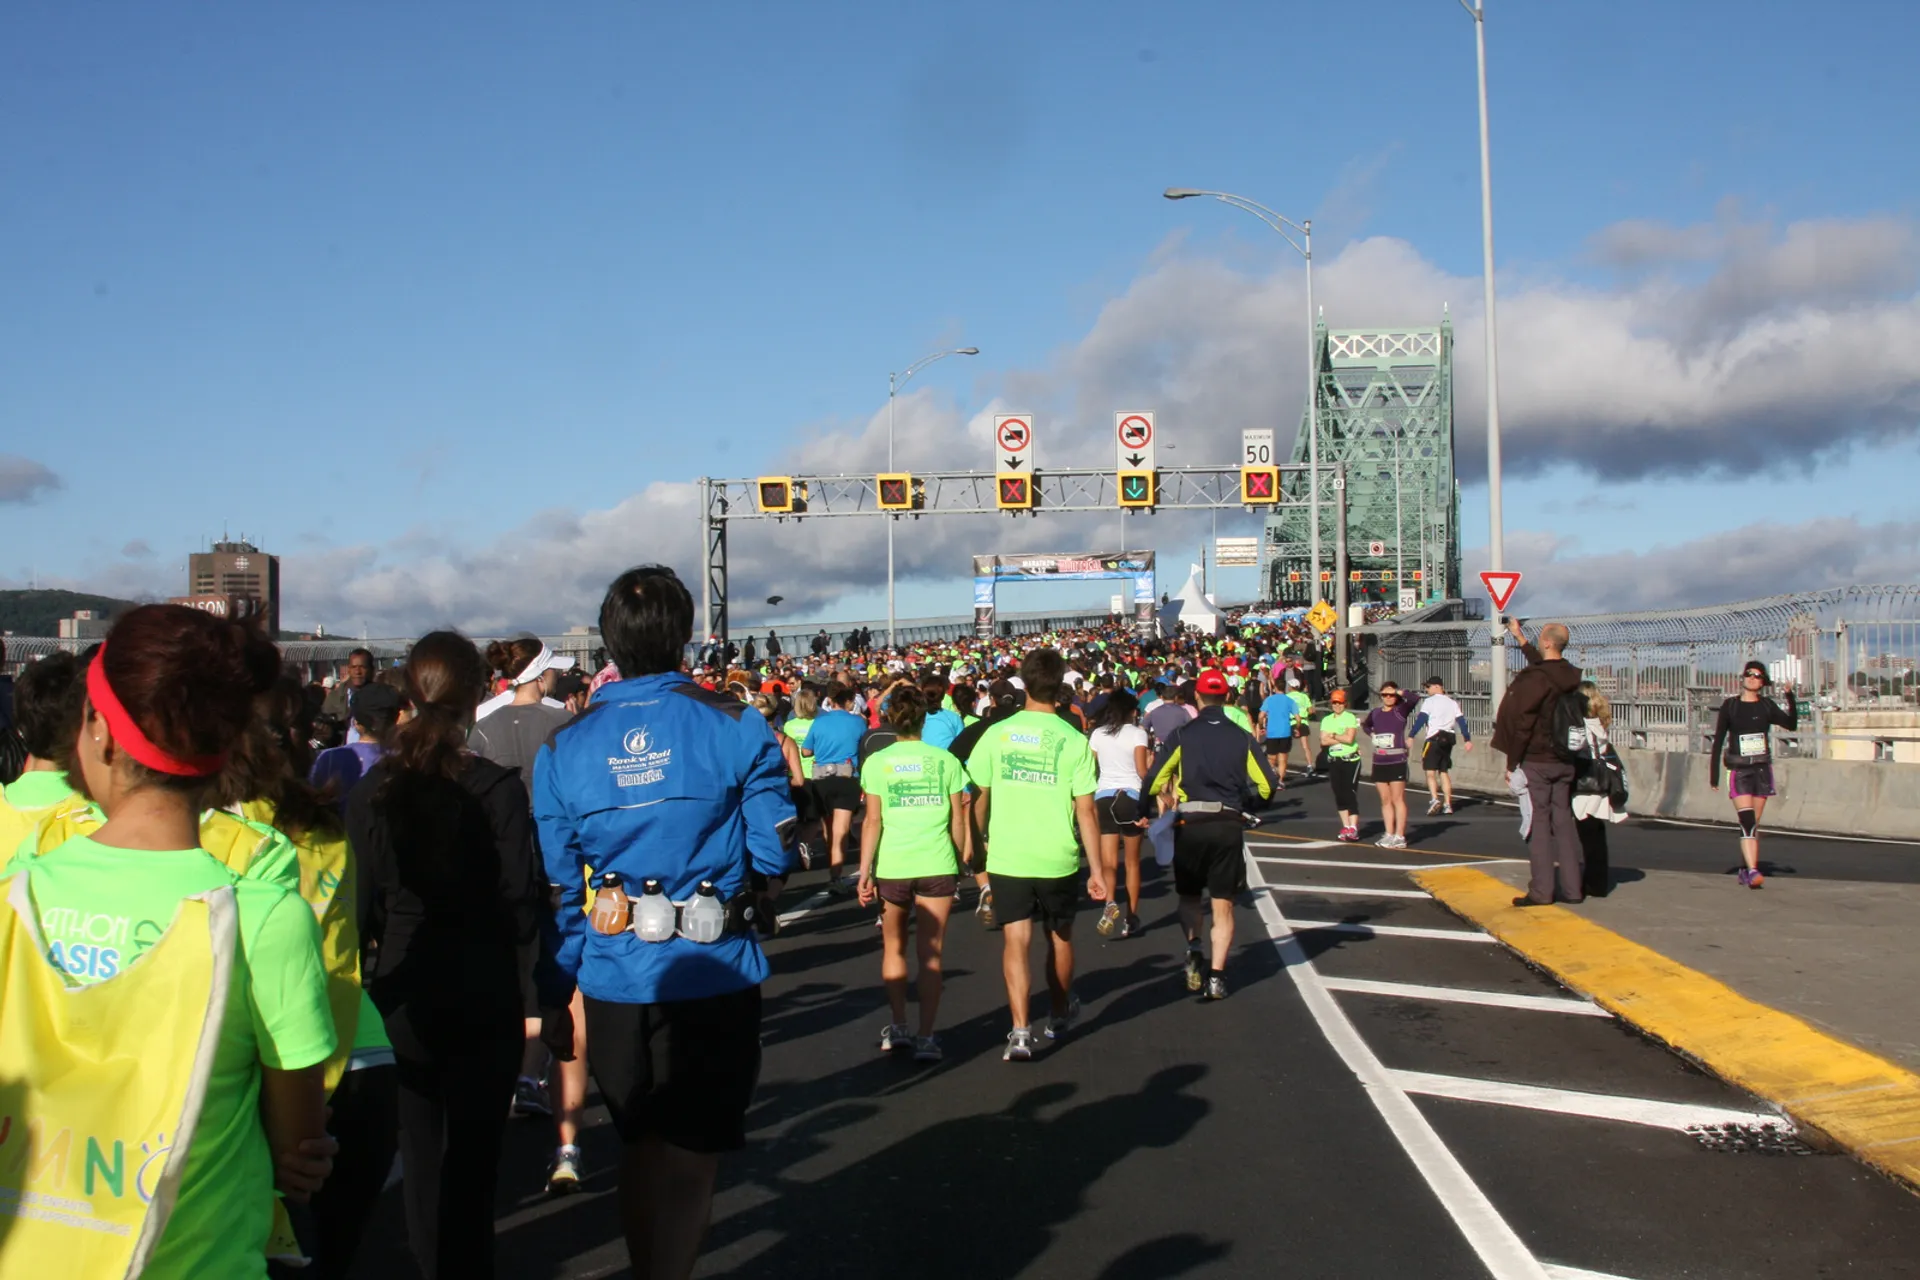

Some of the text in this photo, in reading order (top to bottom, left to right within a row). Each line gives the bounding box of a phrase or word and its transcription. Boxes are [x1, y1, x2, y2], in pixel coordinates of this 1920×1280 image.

[1246, 445, 1270, 464] 50
[1335, 480, 1342, 488] 9
[1401, 597, 1413, 608] 50
[1010, 733, 1040, 745] OASIS
[607, 756, 638, 766] Rock
[647, 748, 671, 761] Roll
[894, 764, 922, 773] OASIS
